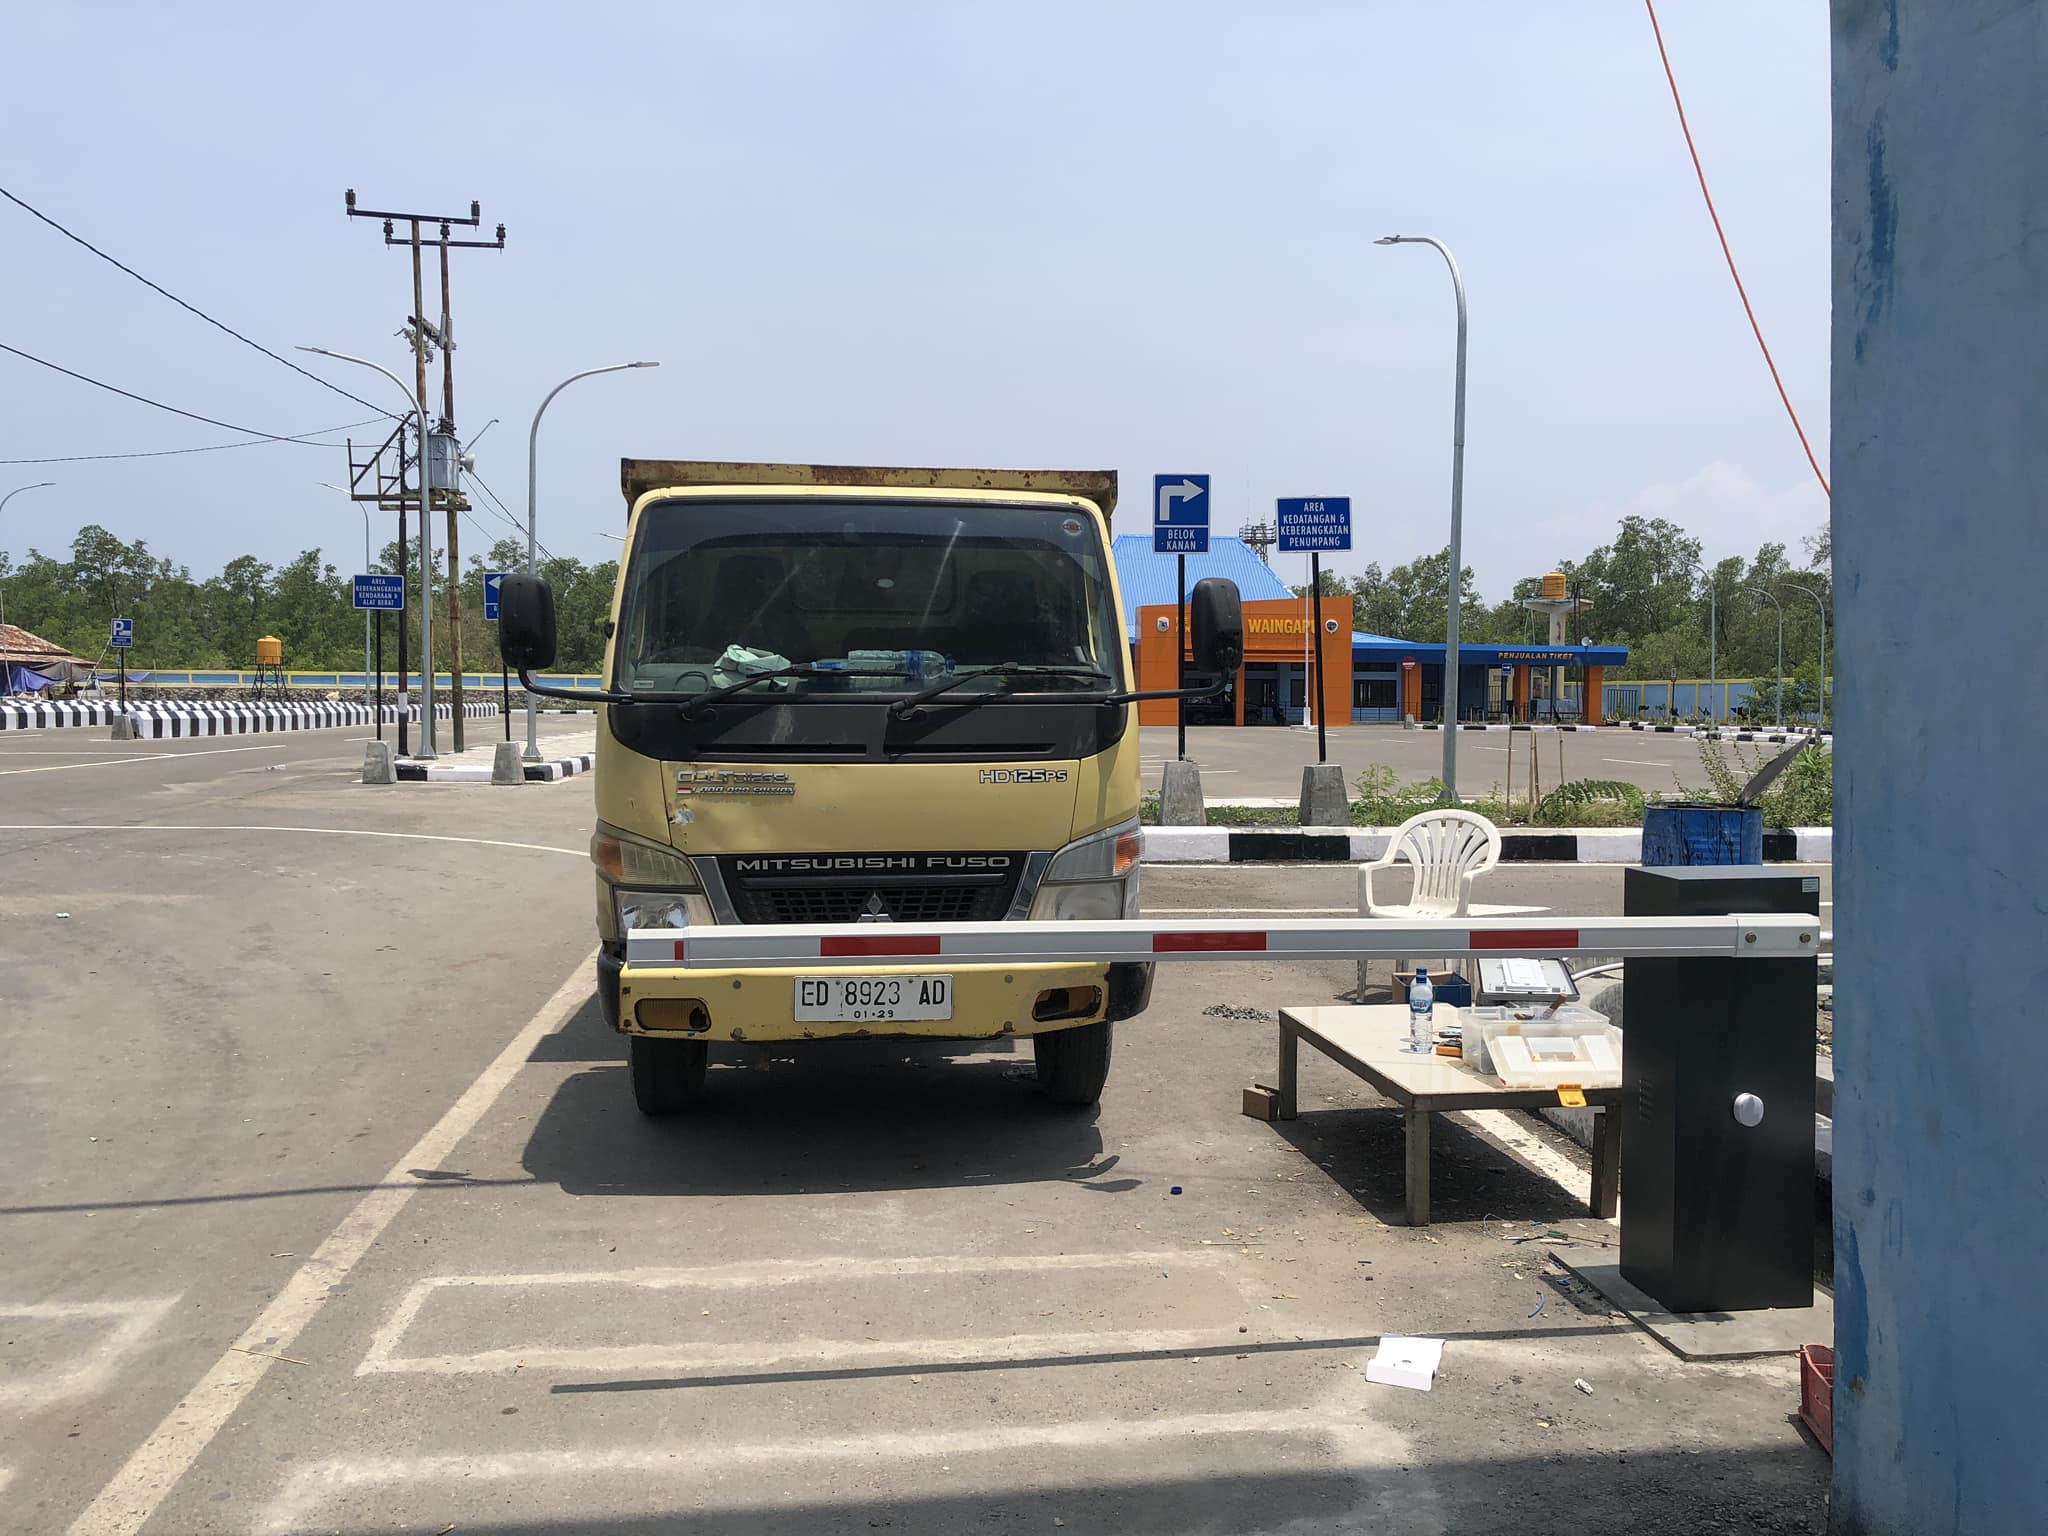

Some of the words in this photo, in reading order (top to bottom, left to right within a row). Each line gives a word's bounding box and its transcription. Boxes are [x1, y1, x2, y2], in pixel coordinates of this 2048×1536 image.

[1303, 502, 1325, 512] AREA
[1283, 513, 1336, 525] KEDATANGAN
[1339, 513, 1345, 524] &
[1167, 529, 1195, 540] BELOK
[1280, 525, 1349, 536] KEBERANGKATAN
[1166, 540, 1197, 551] KANAN
[1289, 536, 1341, 547] PENUMPANG
[113, 620, 125, 636] P
[1498, 652, 1547, 660] PENJUALAN
[979, 769, 1068, 784] HD125PS
[737, 858, 915, 871] MITSUBISHI
[926, 856, 1010, 868] FUSO
[801, 980, 829, 1007] ED
[844, 981, 900, 1006] 8923
[918, 980, 945, 1005] AD
